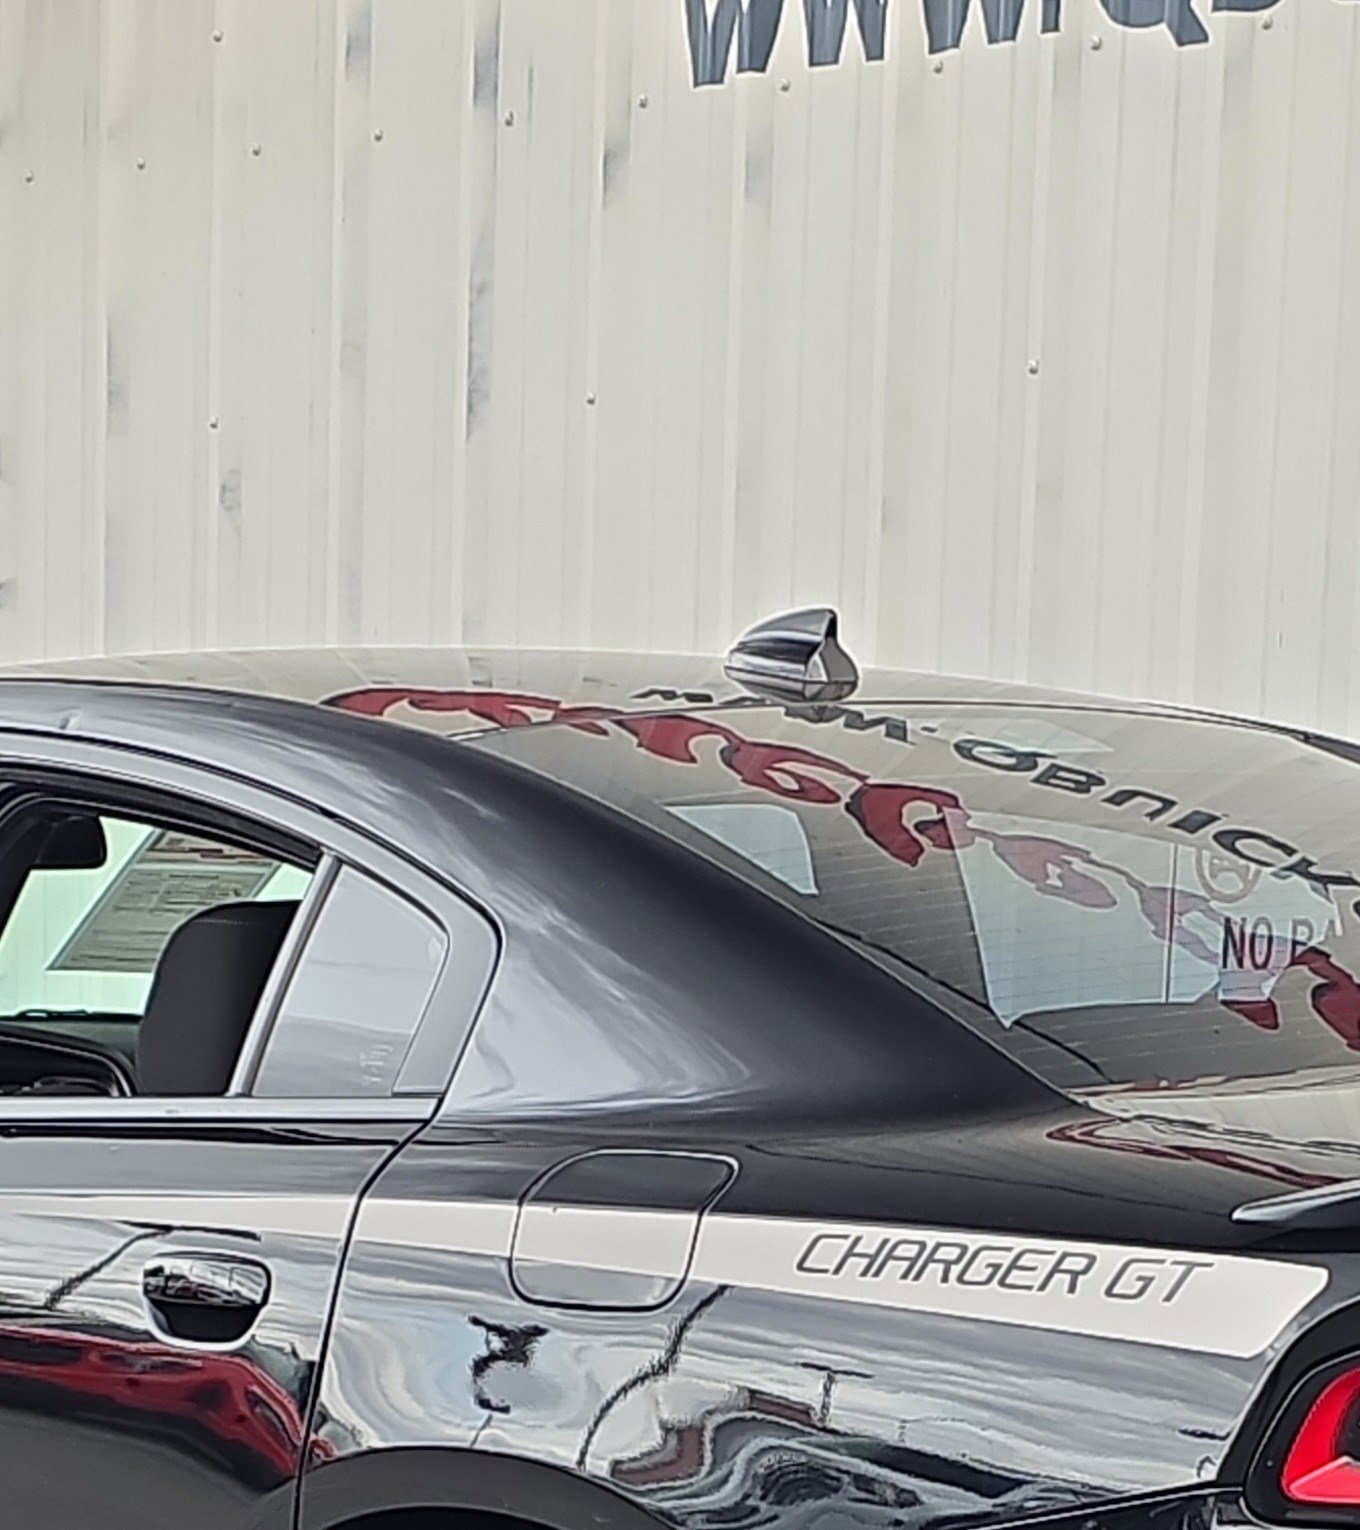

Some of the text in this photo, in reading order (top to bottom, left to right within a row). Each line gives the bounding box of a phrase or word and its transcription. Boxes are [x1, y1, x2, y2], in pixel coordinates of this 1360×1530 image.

[1222, 916, 1274, 970] NO
[795, 1233, 1216, 1304] CHARGER GT
